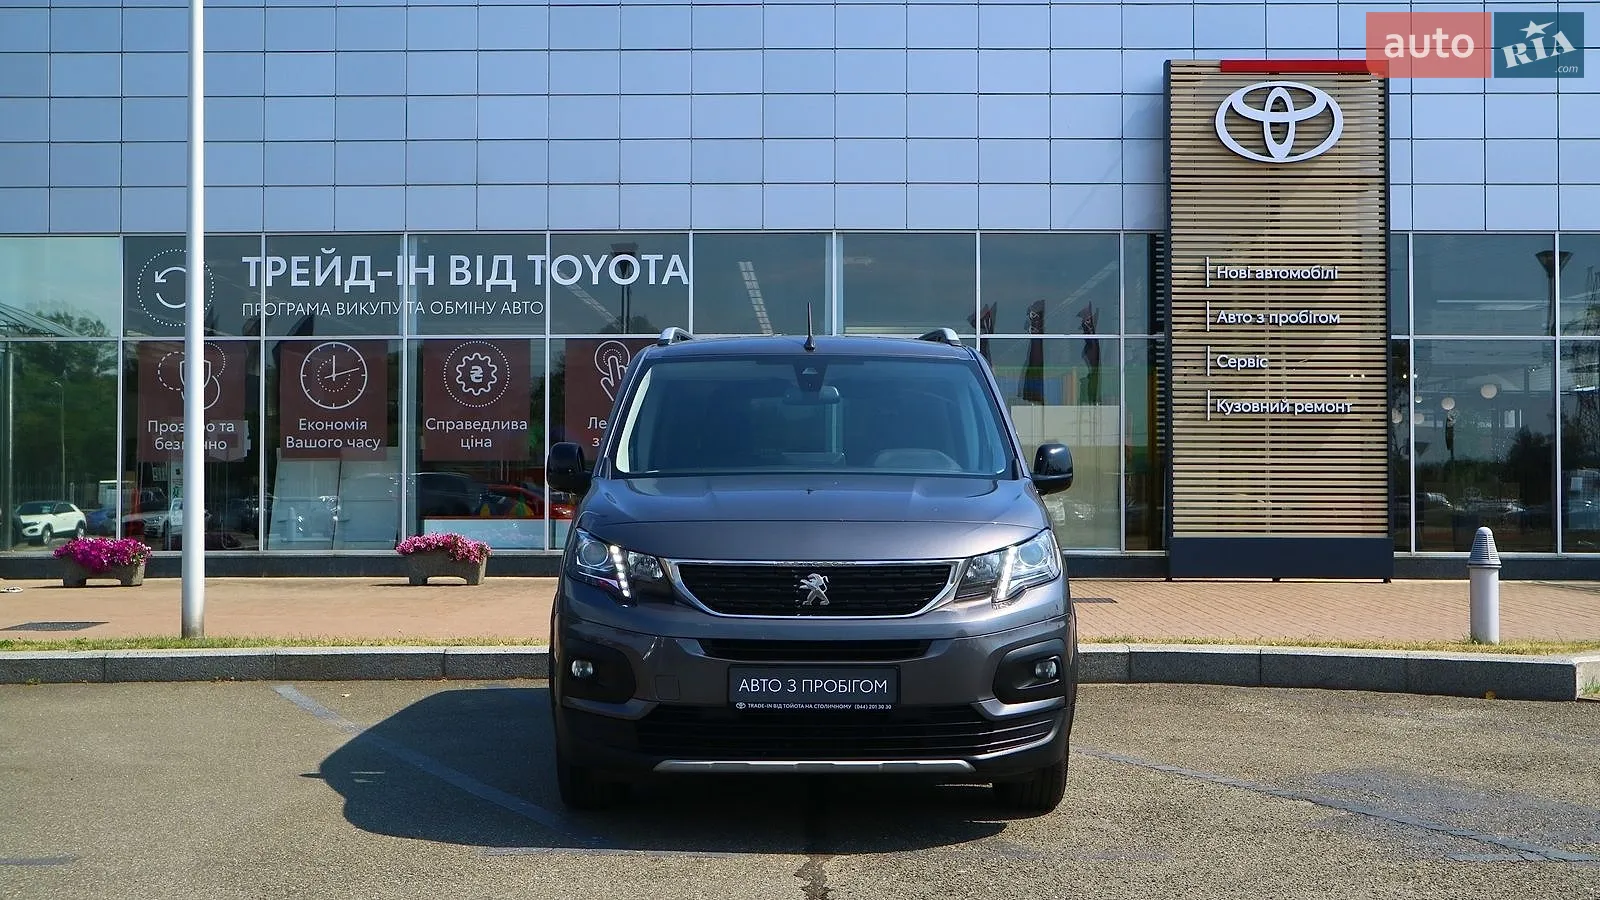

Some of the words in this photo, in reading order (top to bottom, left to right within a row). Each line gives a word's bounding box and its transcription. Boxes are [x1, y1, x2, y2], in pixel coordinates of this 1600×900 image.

[241, 247, 435, 294] ТРЕЙД-ІН
[449, 254, 517, 293] ВІД
[527, 253, 690, 286] TOYOTA
[1217, 265, 1250, 280] Нові
[1255, 265, 1339, 280] автомобілі
[242, 302, 331, 317] ПРОГРАМА
[336, 302, 401, 315] ВИКУПУ
[406, 301, 425, 314] ТА
[430, 301, 496, 315] ОБМІНУ
[500, 301, 544, 315] АВТО
[1217, 310, 1252, 324] Авто
[1256, 312, 1265, 324] з
[1269, 310, 1341, 326] пробігом
[1216, 355, 1269, 371] Сервіс
[1217, 398, 1290, 415] Кузовний
[1294, 402, 1353, 415] ремонт
[148, 420, 215, 436] Прозо
[219, 422, 235, 432] та
[299, 418, 367, 431] Економія
[425, 418, 528, 433] Справедлива
[286, 436, 343, 448] Вашого
[347, 438, 381, 451] часу
[461, 435, 492, 450] ціна
[738, 679, 782, 692] АВТО
[802, 679, 888, 693] ПРОБІГОМ
